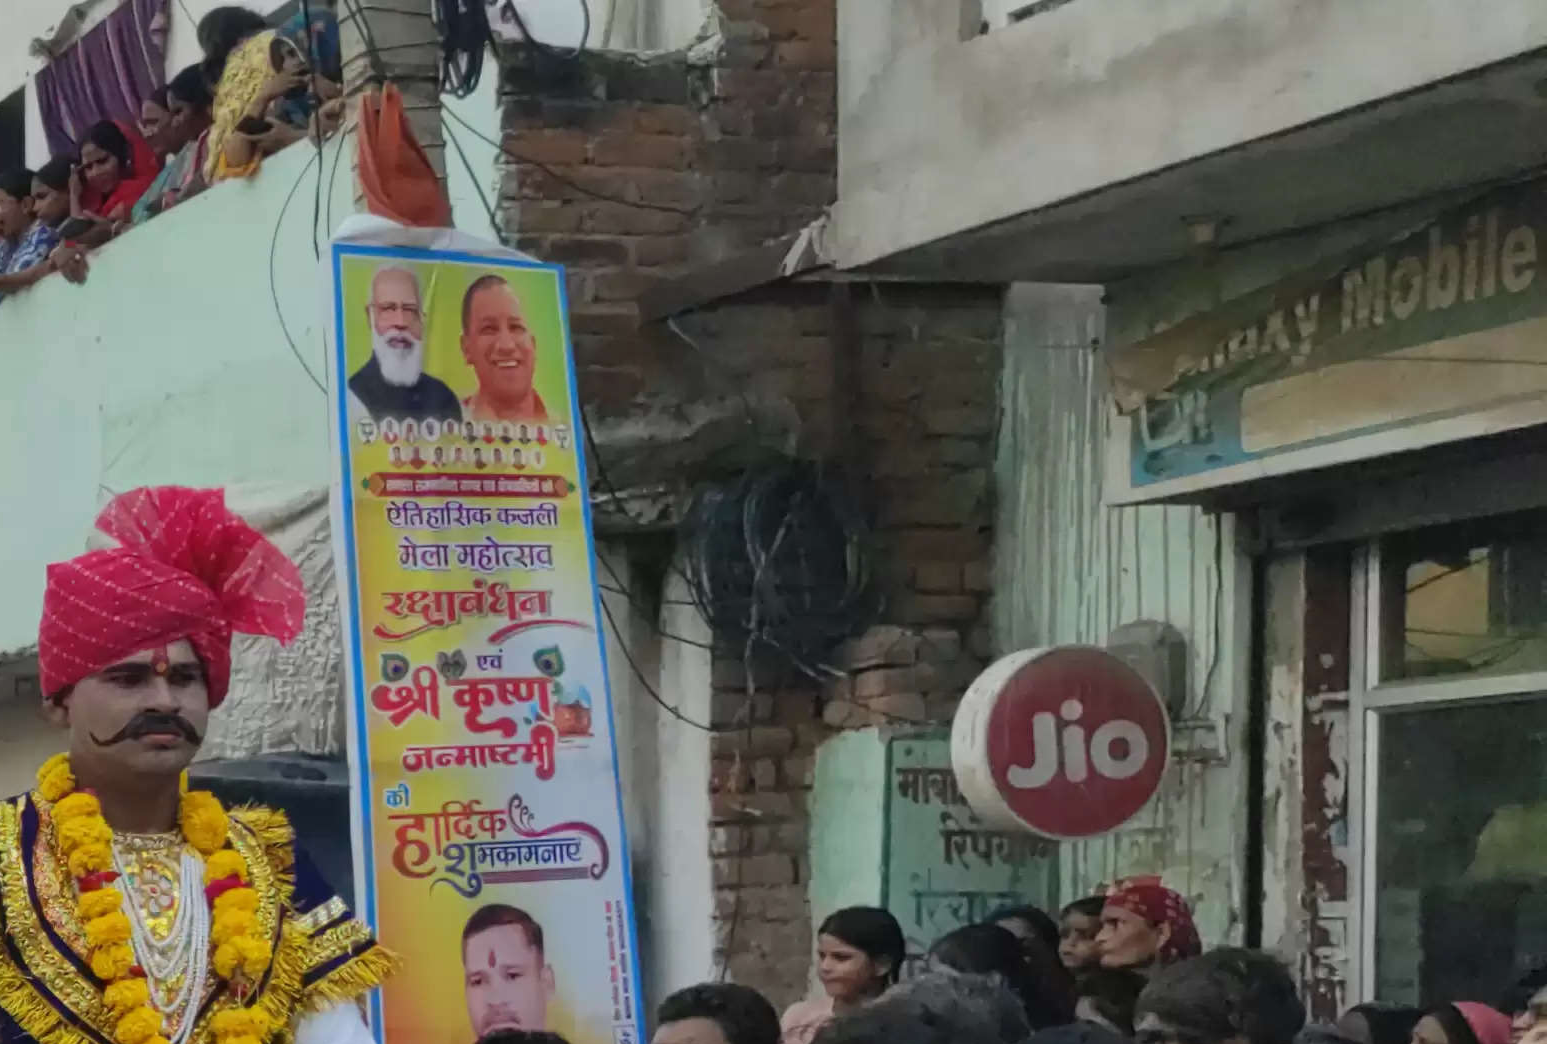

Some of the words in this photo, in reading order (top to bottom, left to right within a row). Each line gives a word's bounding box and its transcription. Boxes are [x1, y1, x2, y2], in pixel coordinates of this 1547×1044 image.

[1340, 206, 1538, 334] Mobile
[386, 500, 492, 529] ऐतिहासिक
[496, 502, 559, 527] कजली
[398, 535, 449, 568] मेला
[454, 535, 553, 571] महोत्सव
[380, 577, 552, 627] रक्षाबंधन
[475, 648, 504, 671] एवं
[370, 665, 440, 727] श्री
[444, 676, 553, 738] कृष्ण
[402, 724, 556, 782] जन्माष्टमी
[1007, 698, 1150, 789] Jio
[386, 783, 410, 808] की
[387, 799, 508, 879] हार्दिक
